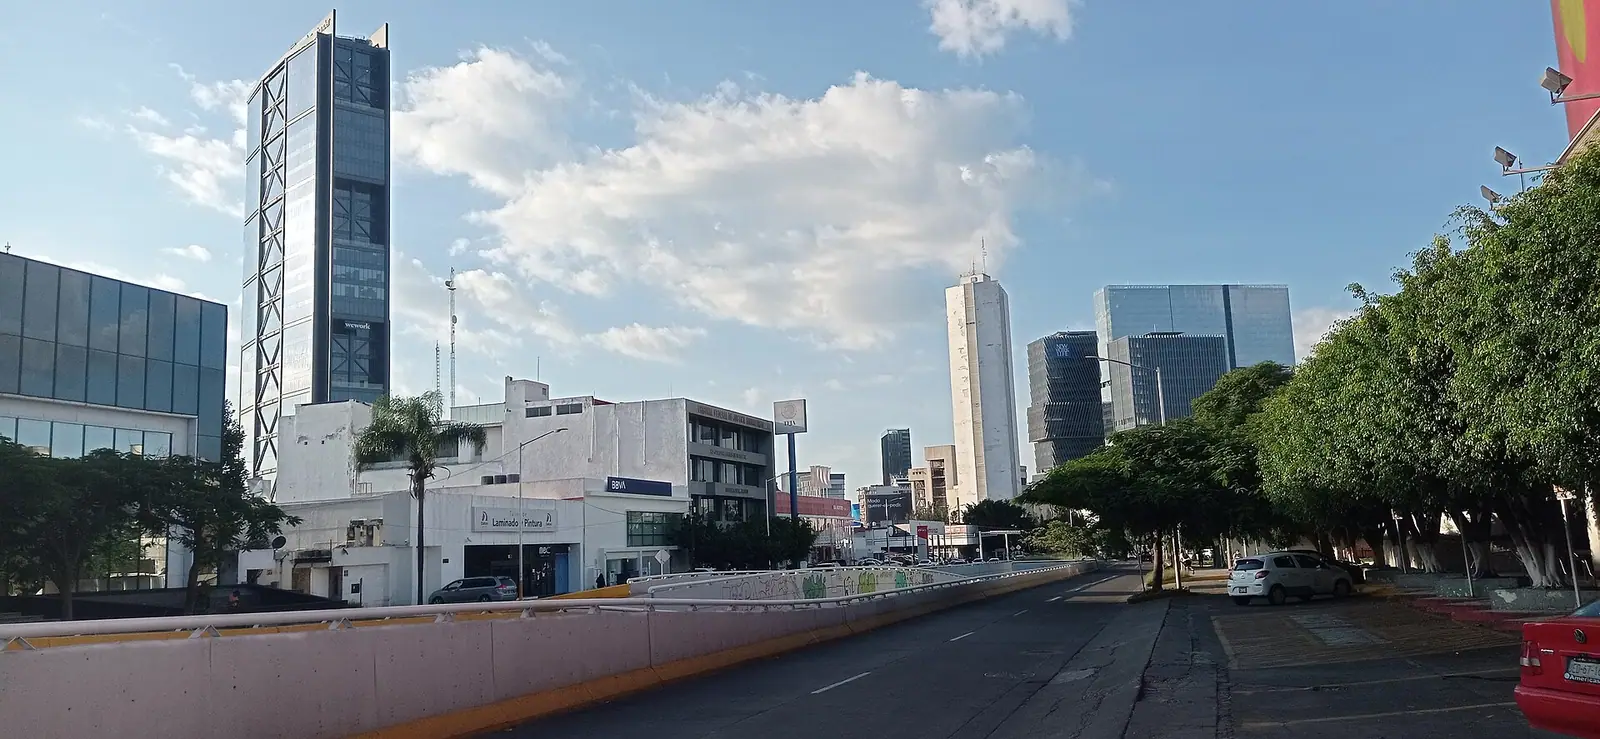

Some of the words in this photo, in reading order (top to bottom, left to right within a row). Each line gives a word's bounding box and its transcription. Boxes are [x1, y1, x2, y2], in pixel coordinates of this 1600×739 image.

[611, 480, 626, 490] BBVA
[492, 518, 518, 528] Laminado
[524, 518, 543, 528] Pintura
